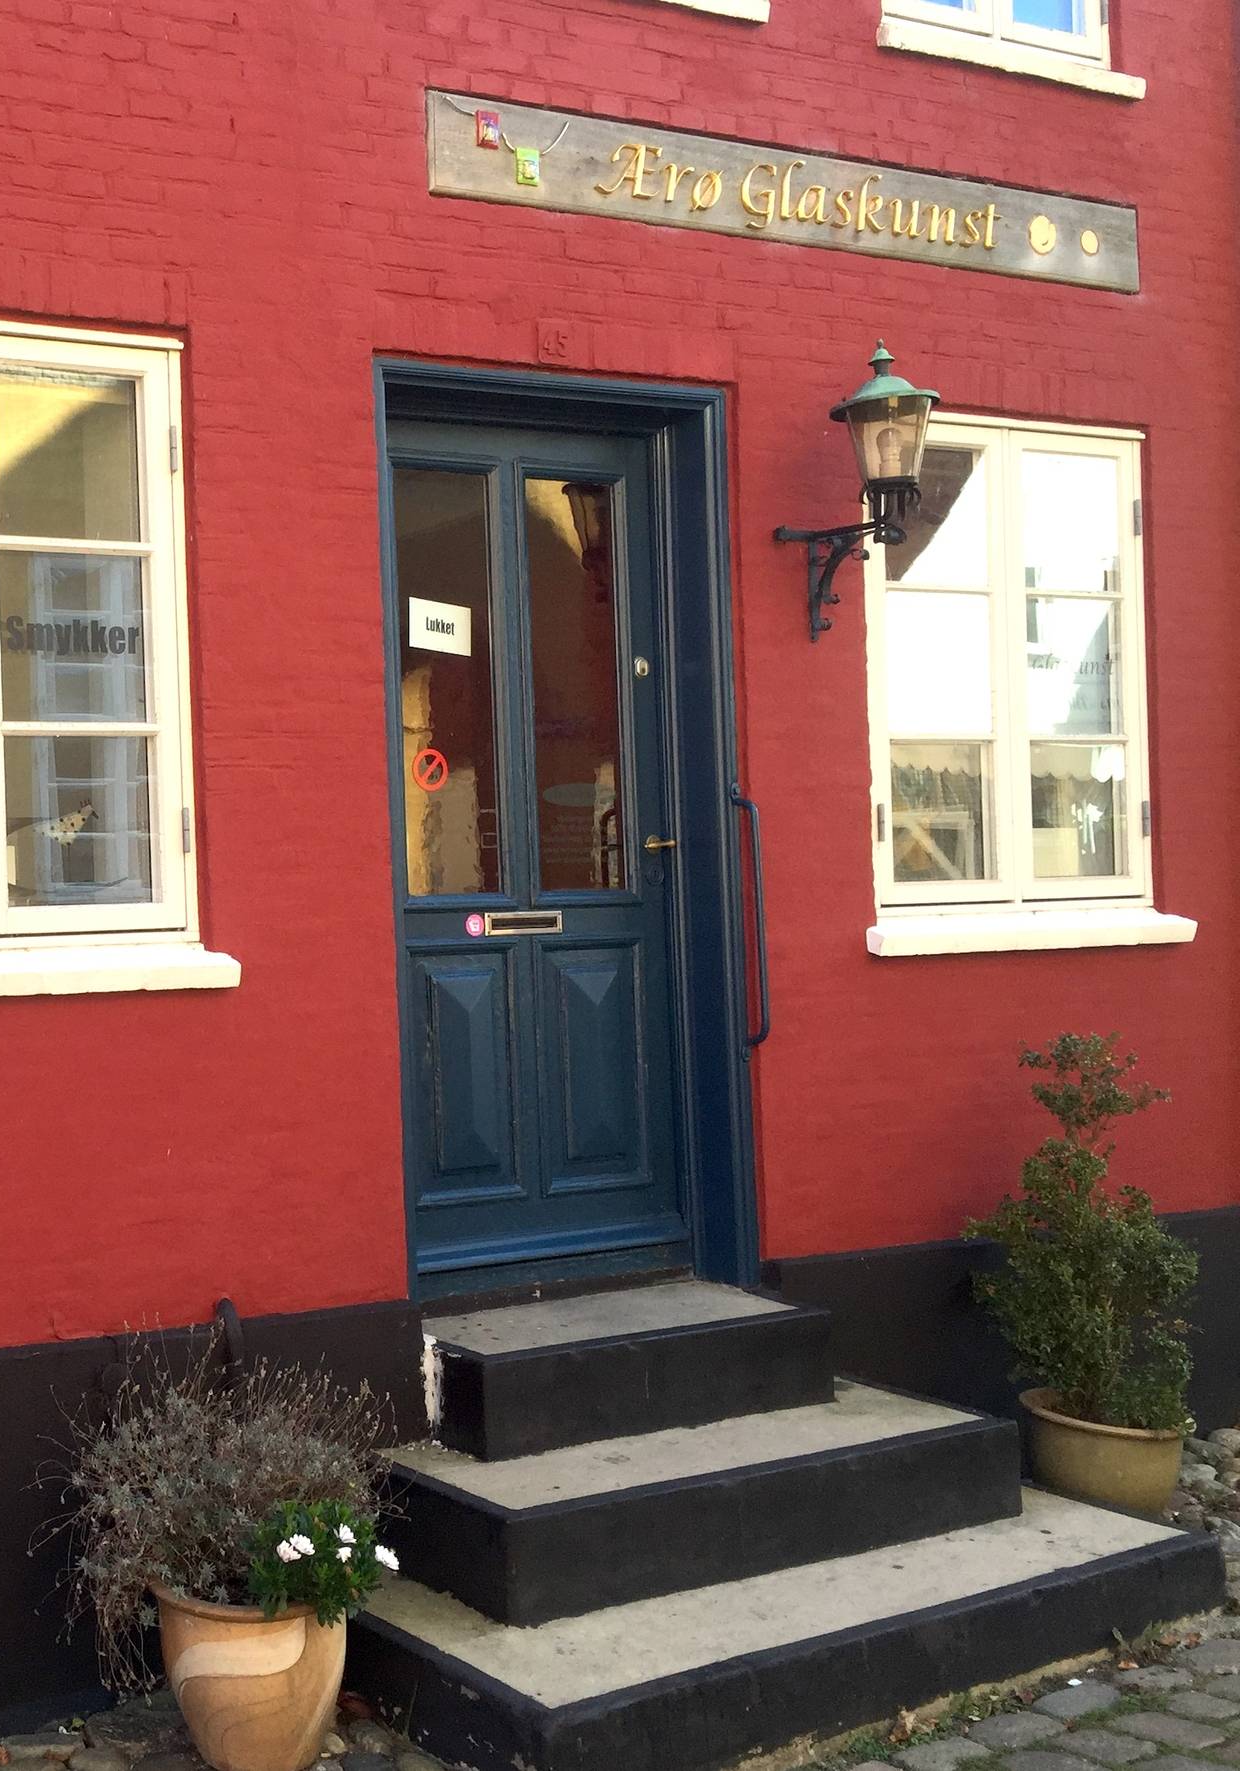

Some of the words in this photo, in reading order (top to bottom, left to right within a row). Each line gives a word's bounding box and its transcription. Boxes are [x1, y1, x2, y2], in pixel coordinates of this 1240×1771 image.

[595, 143, 723, 212] Ærø
[741, 161, 1002, 249] Glaskunst
[6, 615, 140, 655] Smykker
[425, 616, 455, 636] Lukket
